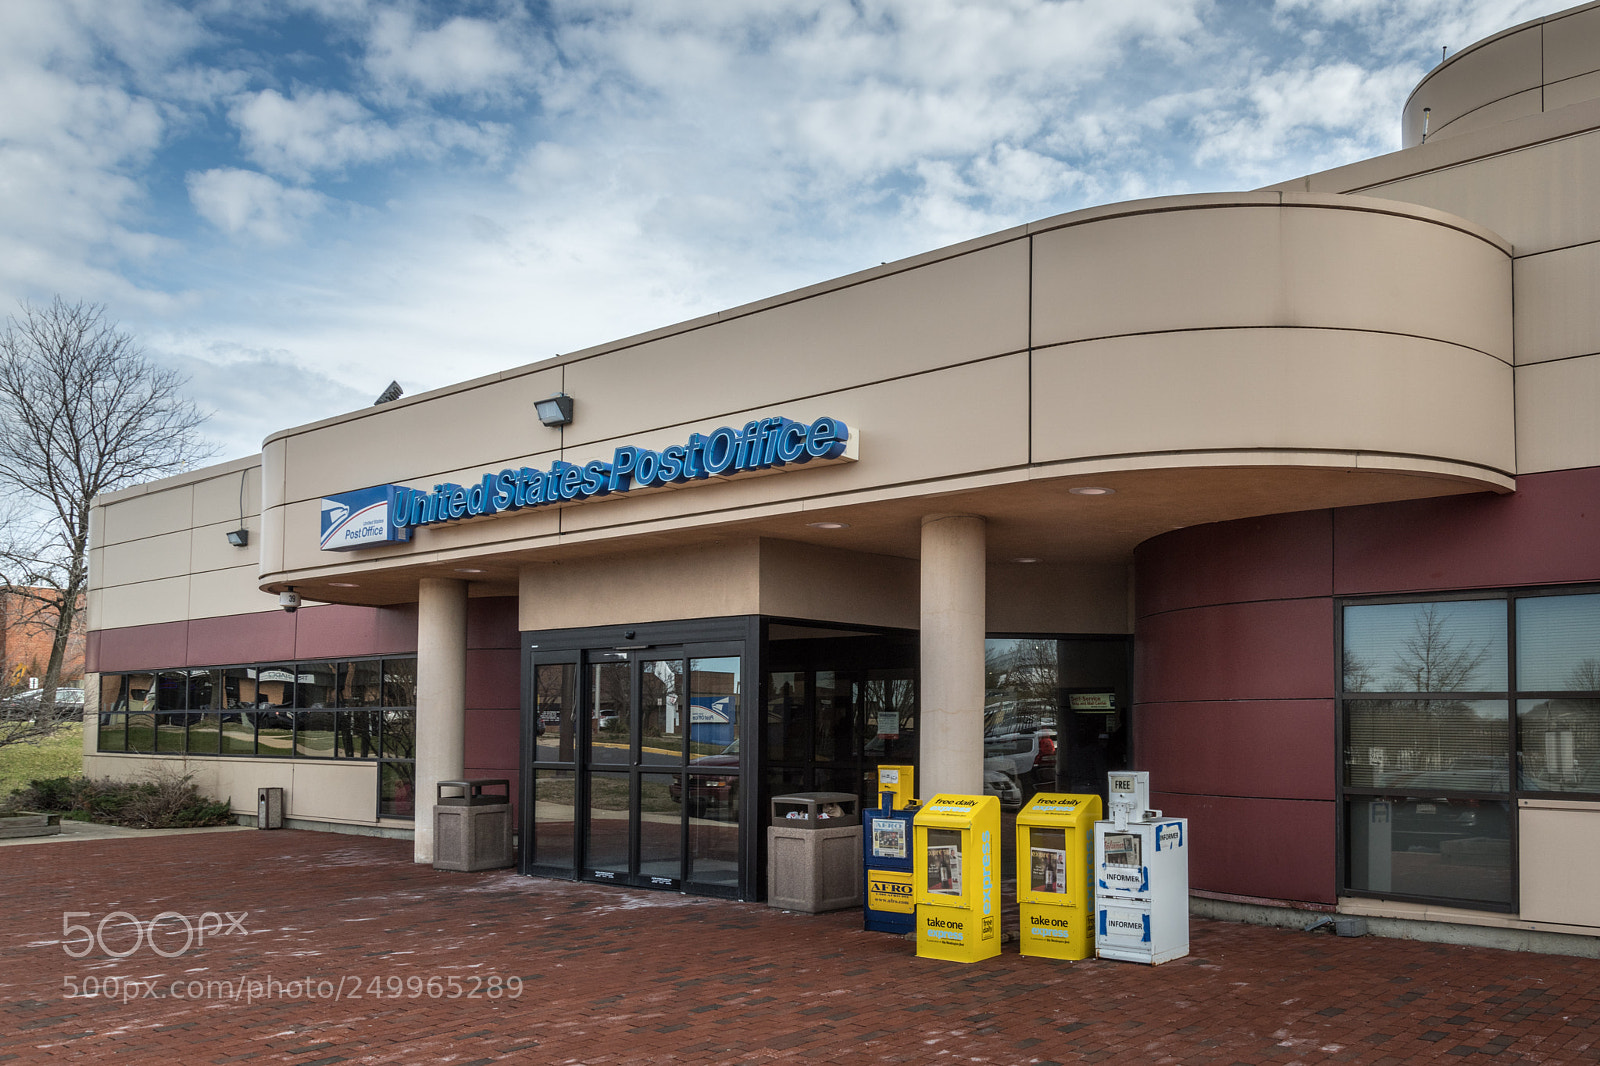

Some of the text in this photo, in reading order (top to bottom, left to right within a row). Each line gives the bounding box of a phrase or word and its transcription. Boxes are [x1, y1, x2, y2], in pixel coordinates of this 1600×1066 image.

[391, 415, 841, 528] United States Post Office
[345, 525, 384, 540] Post Office
[288, 594, 296, 603] 39
[1114, 779, 1131, 790] FREE
[955, 799, 978, 807] daily
[929, 805, 972, 813] express
[1160, 832, 1178, 842] INFORMER
[982, 830, 992, 914] express
[1086, 828, 1096, 913] express
[1106, 873, 1141, 883] INFORMER
[871, 883, 913, 894] AFRO
[927, 917, 963, 930] take one
[1031, 915, 1069, 928] take one
[1108, 919, 1143, 930] INFORMER
[927, 928, 964, 941] express
[1031, 926, 1069, 938] express
